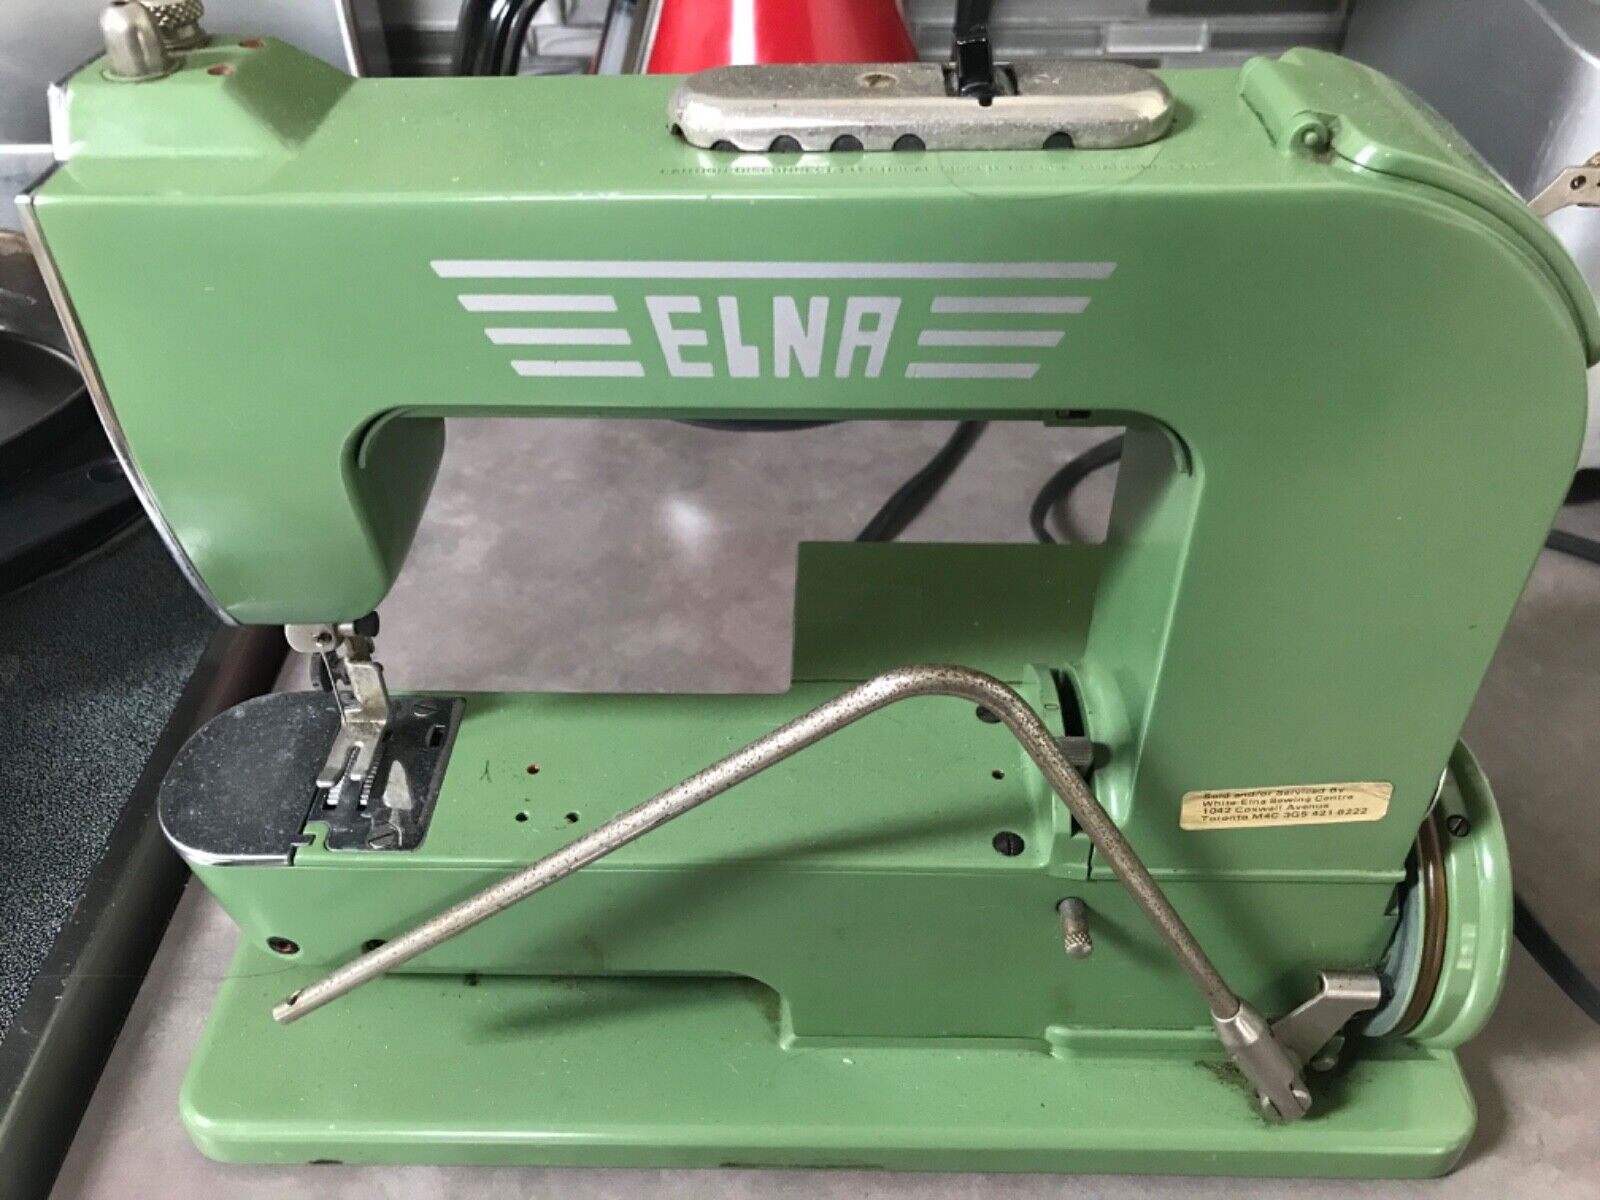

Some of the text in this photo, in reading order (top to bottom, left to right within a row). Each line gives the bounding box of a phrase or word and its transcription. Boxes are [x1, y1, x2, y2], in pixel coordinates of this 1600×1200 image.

[644, 295, 902, 378] ELNA
[1270, 796, 1312, 804] Sewing
[1315, 794, 1354, 802] Centre
[1203, 803, 1329, 815] 1042 Coxwell Avenue
[1201, 814, 1249, 823] Toronto
[1252, 812, 1279, 820] M4C
[1312, 809, 1332, 817] 421
